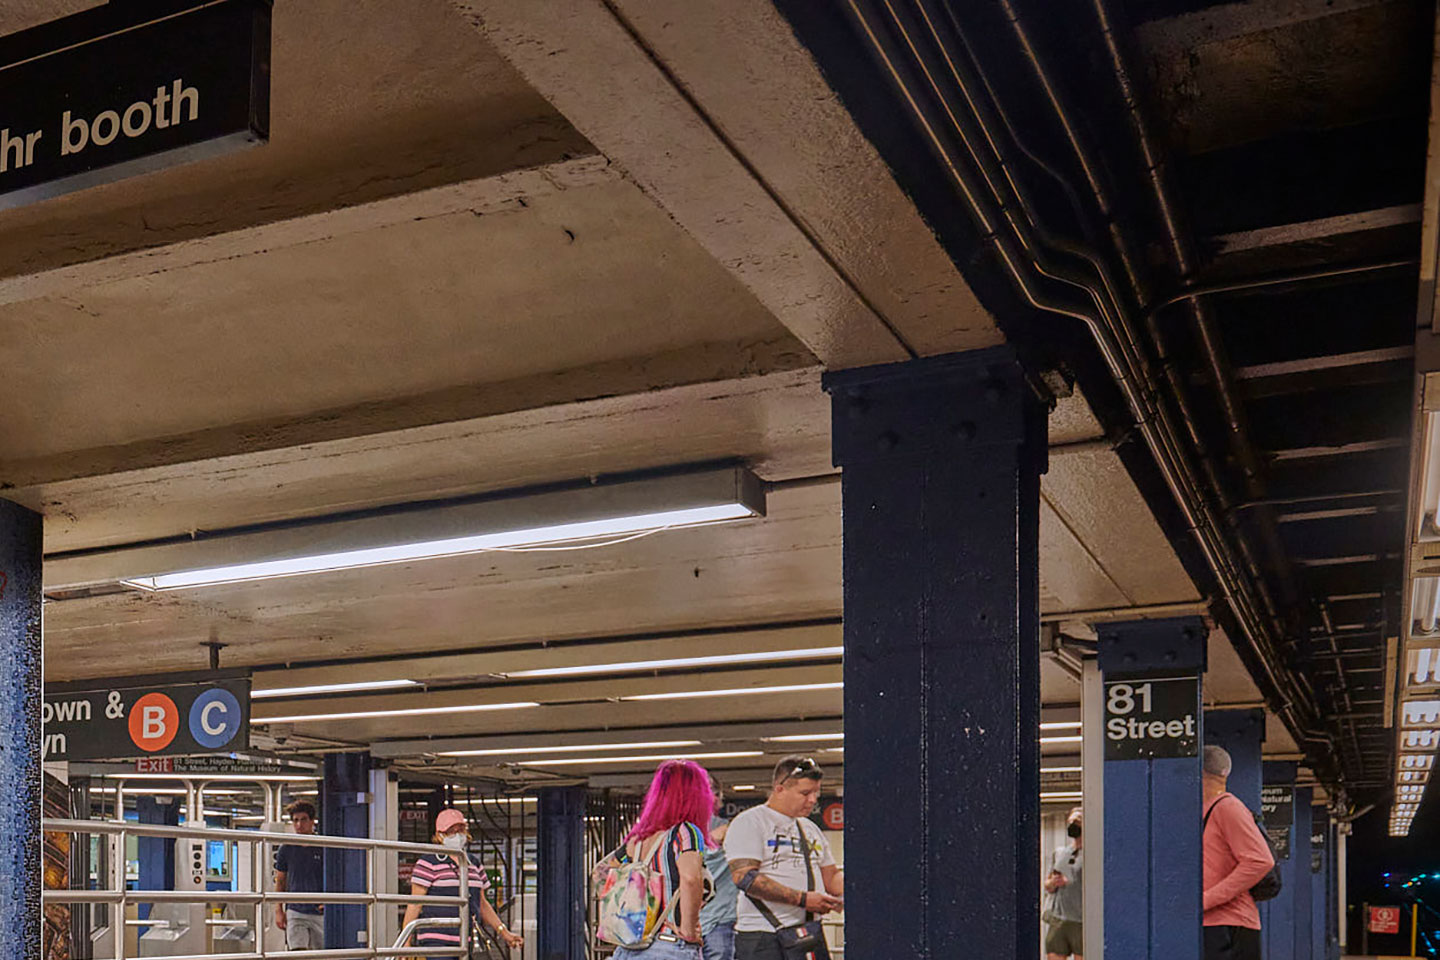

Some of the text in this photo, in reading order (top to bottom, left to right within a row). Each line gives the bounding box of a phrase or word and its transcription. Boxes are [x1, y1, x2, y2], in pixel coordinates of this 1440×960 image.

[0, 128, 42, 175] hr
[61, 78, 200, 156] booth
[1107, 683, 1152, 715] 81
[105, 691, 124, 719] &
[142, 706, 166, 739] B
[201, 701, 227, 736] C
[1107, 715, 1195, 740] Street
[137, 758, 169, 773] Exit
[231, 765, 255, 773] Natural
[407, 811, 427, 820] EXIT
